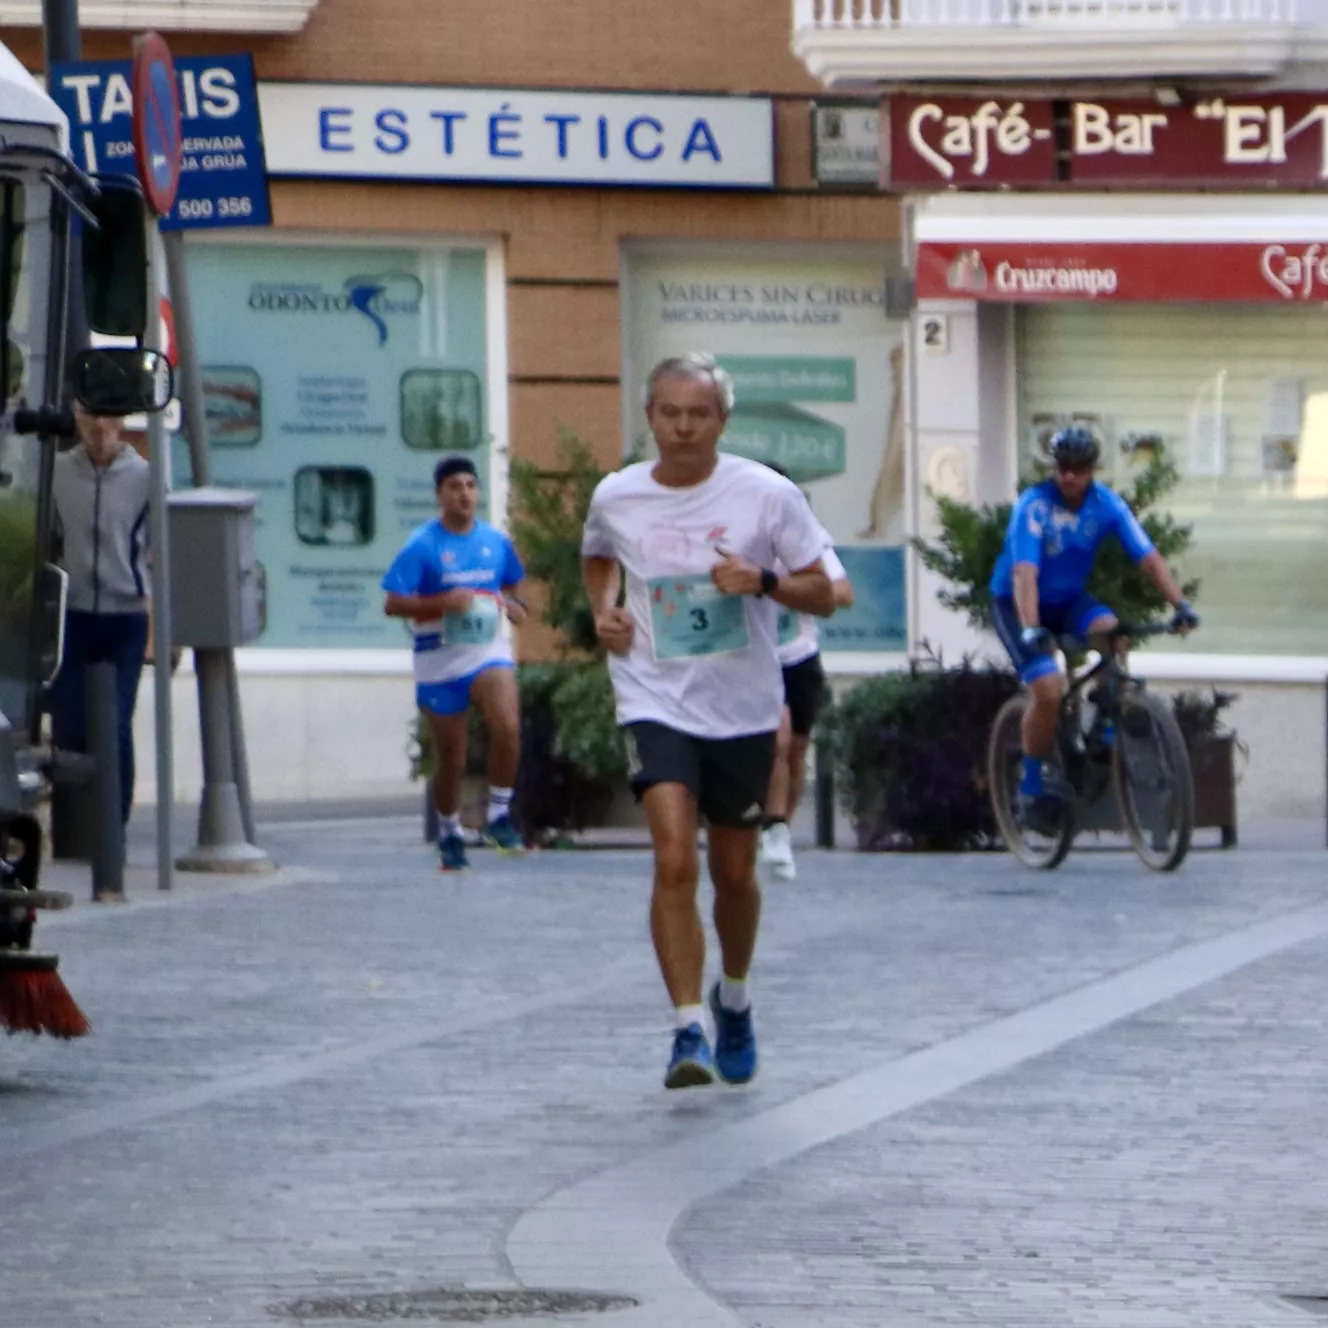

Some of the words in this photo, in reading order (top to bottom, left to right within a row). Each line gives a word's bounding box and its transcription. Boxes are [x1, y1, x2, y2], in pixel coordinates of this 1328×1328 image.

[62, 67, 240, 124] TAIS
[318, 103, 722, 162] ESTÉTICA
[1075, 102, 1168, 154] Bar
[181, 134, 244, 152] ERVADA
[178, 202, 213, 217] 500
[218, 197, 252, 215] 356
[996, 261, 1118, 293] Cruzcampo
[658, 281, 752, 303] VARICES
[761, 284, 799, 303] SIN
[806, 282, 887, 308] CIRUG
[924, 319, 941, 346] 2
[690, 607, 709, 631] 3
